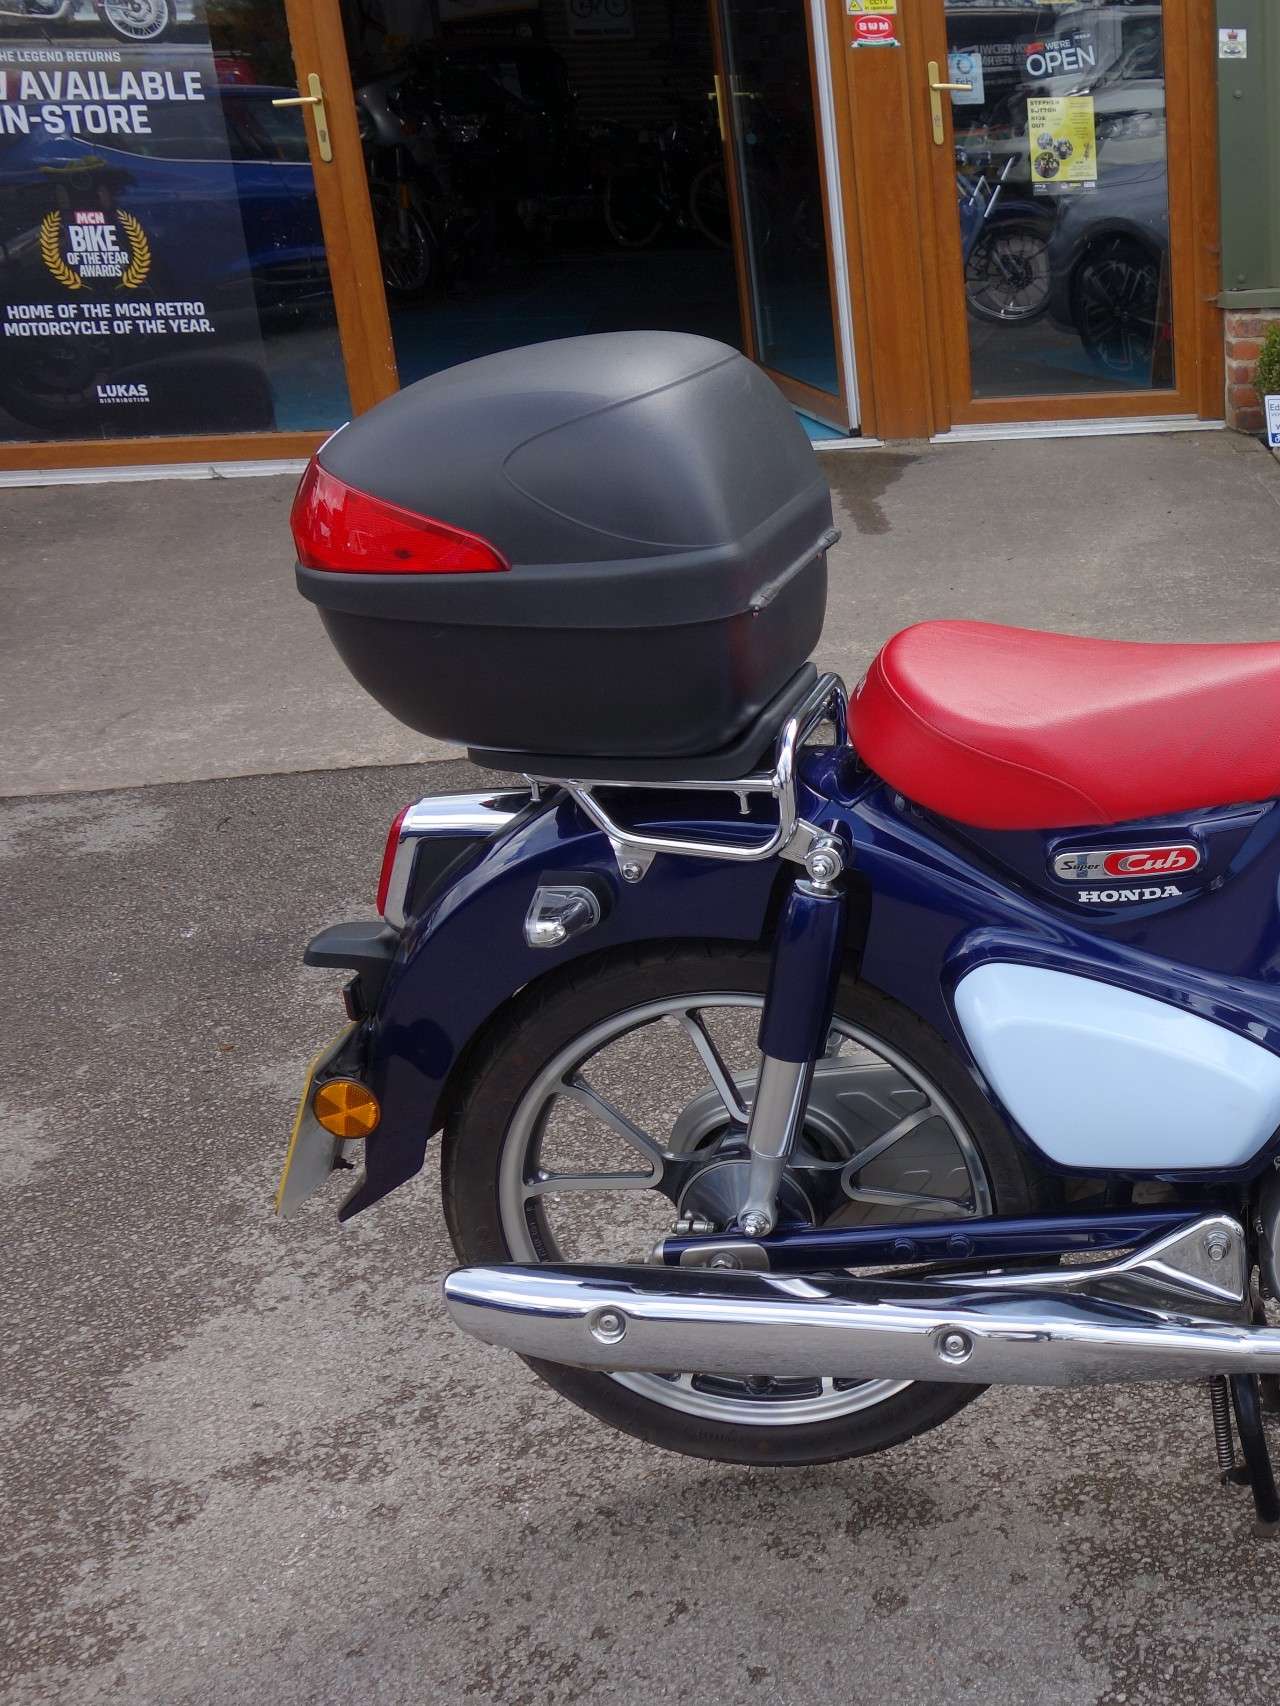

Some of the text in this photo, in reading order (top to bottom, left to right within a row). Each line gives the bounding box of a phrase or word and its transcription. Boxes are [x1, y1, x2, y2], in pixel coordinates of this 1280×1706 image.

[17, 51, 64, 62] LEGEND
[66, 51, 121, 62] RETURNS
[1026, 46, 1095, 76] OPEN
[20, 71, 205, 100] AVAILABLE
[76, 212, 105, 224] MCN
[68, 225, 120, 251] BIKE
[66, 252, 129, 264] OF THE YEAR
[79, 265, 122, 277] AWARDS
[6, 302, 205, 319] HOME OF THE MCN RETRO
[3, 318, 215, 336] MOTORCYCLE OF THE YEAR.
[97, 384, 149, 397] LUKAS
[1060, 850, 1187, 872] Super Cub
[1078, 885, 1182, 903] HONDA
